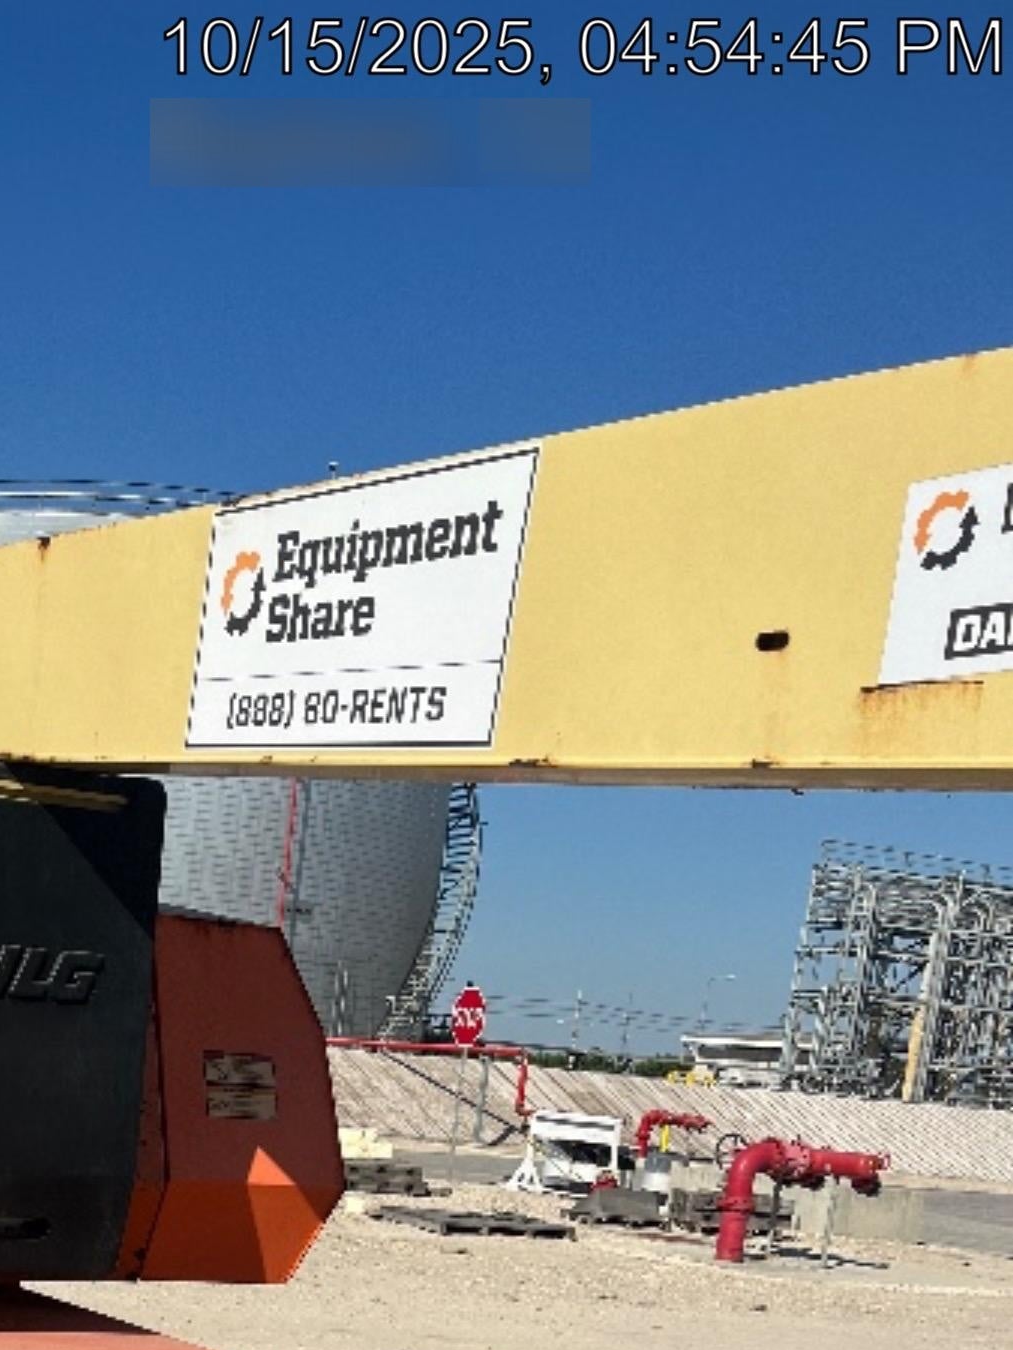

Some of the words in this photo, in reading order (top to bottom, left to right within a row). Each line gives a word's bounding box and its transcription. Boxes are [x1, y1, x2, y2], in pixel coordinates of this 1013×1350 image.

[272, 500, 503, 588] Equipment
[266, 592, 375, 643] Share
[227, 688, 296, 729] (888)
[303, 686, 447, 725] 80-RENTS
